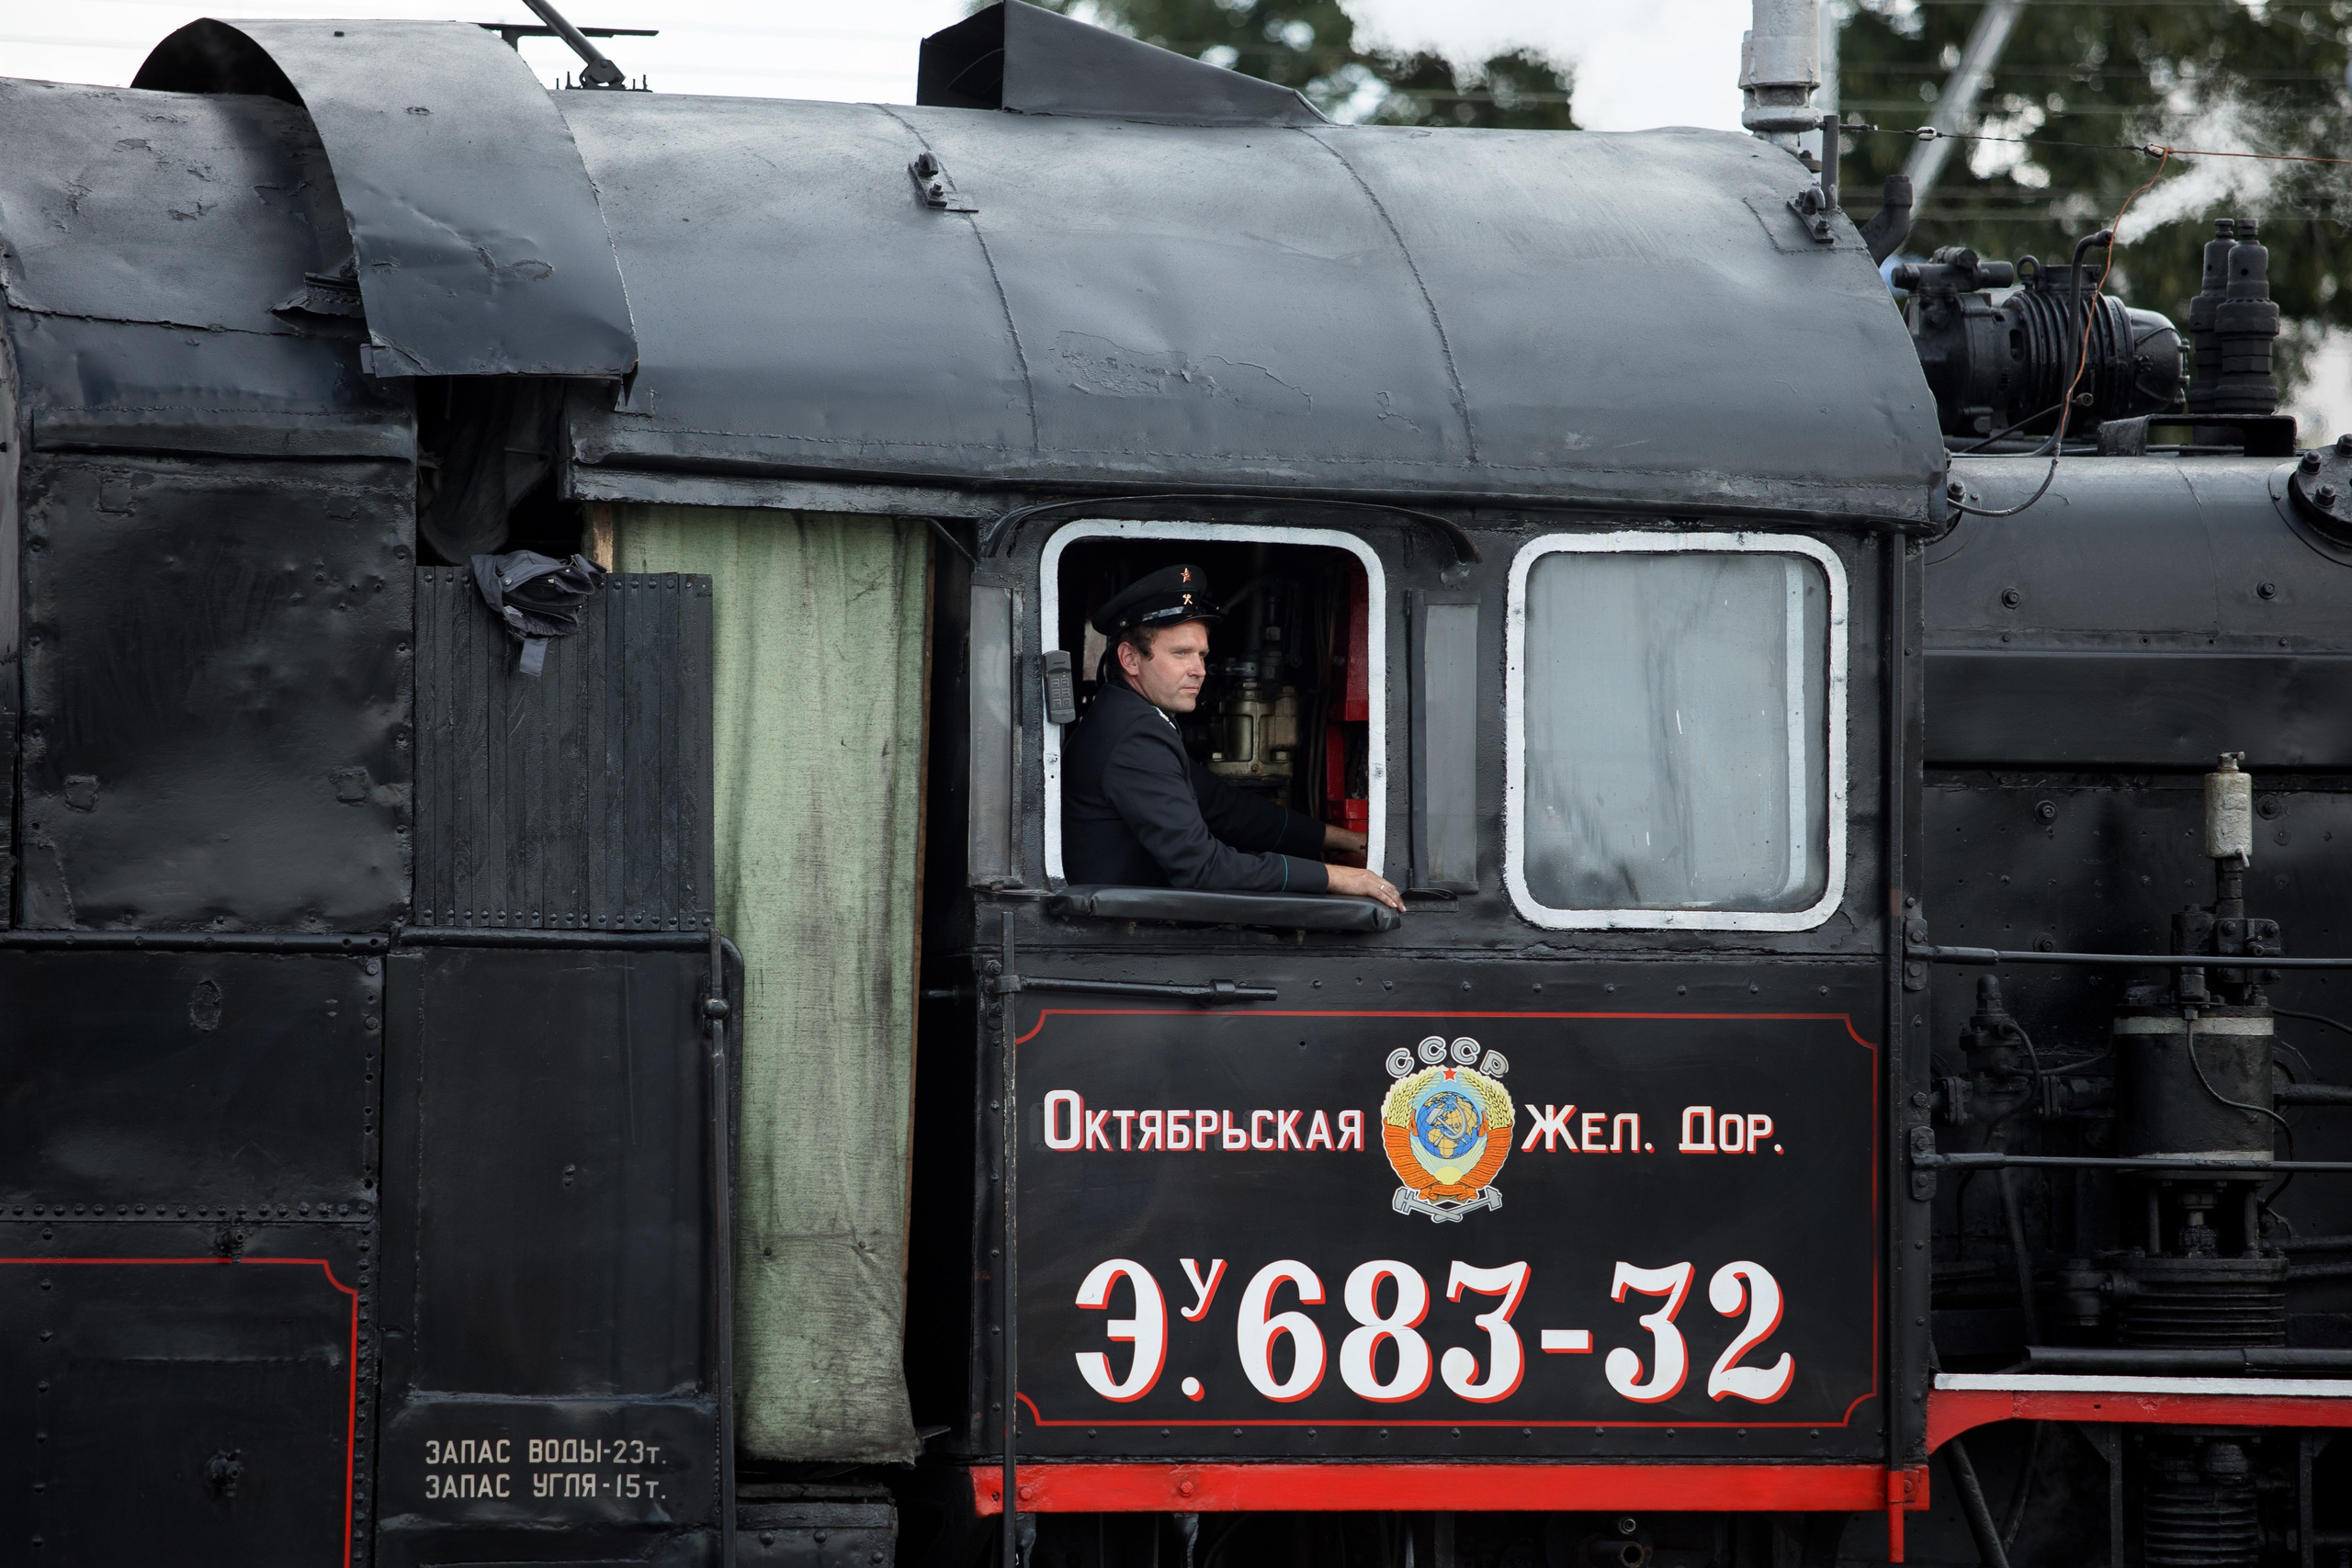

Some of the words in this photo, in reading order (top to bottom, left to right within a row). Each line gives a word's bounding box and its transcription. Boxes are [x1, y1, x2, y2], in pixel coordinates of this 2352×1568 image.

[1385, 1035, 1509, 1077] СССР
[425, 1439, 511, 1464] ЗАПАС
[425, 1473, 511, 1499] ЗАПАС
